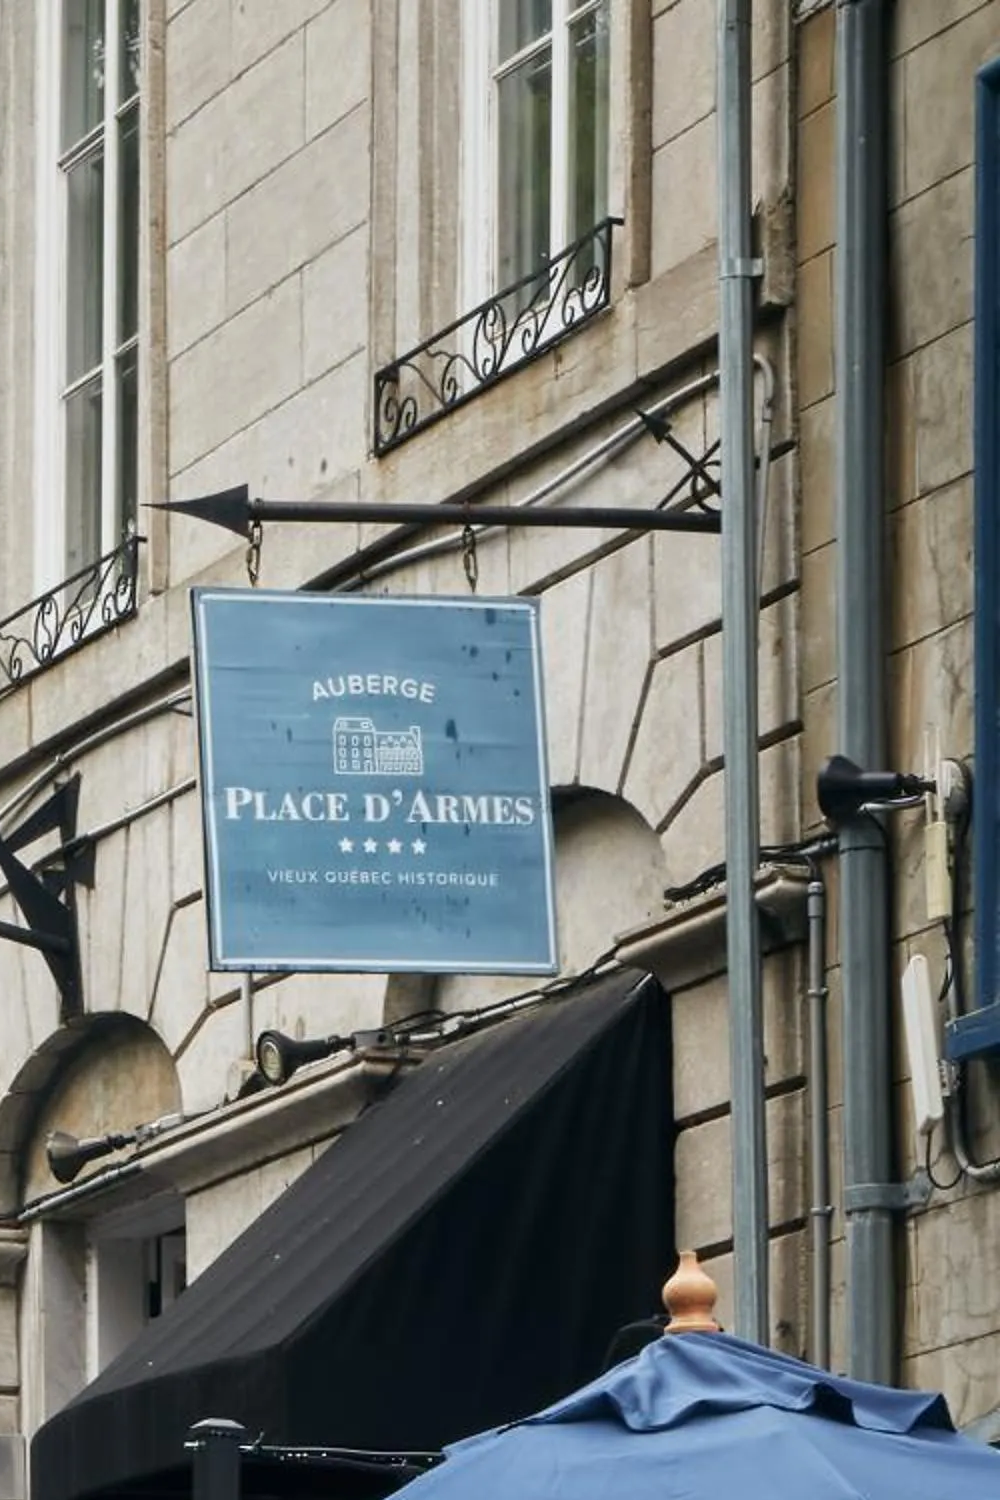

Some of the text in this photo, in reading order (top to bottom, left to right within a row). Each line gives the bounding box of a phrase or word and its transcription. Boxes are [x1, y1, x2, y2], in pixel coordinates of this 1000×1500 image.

[312, 675, 436, 703] AUBERGE
[224, 787, 349, 821] PLACE
[267, 870, 319, 884] VIEUX
[398, 872, 500, 887] HISTORIQUE
